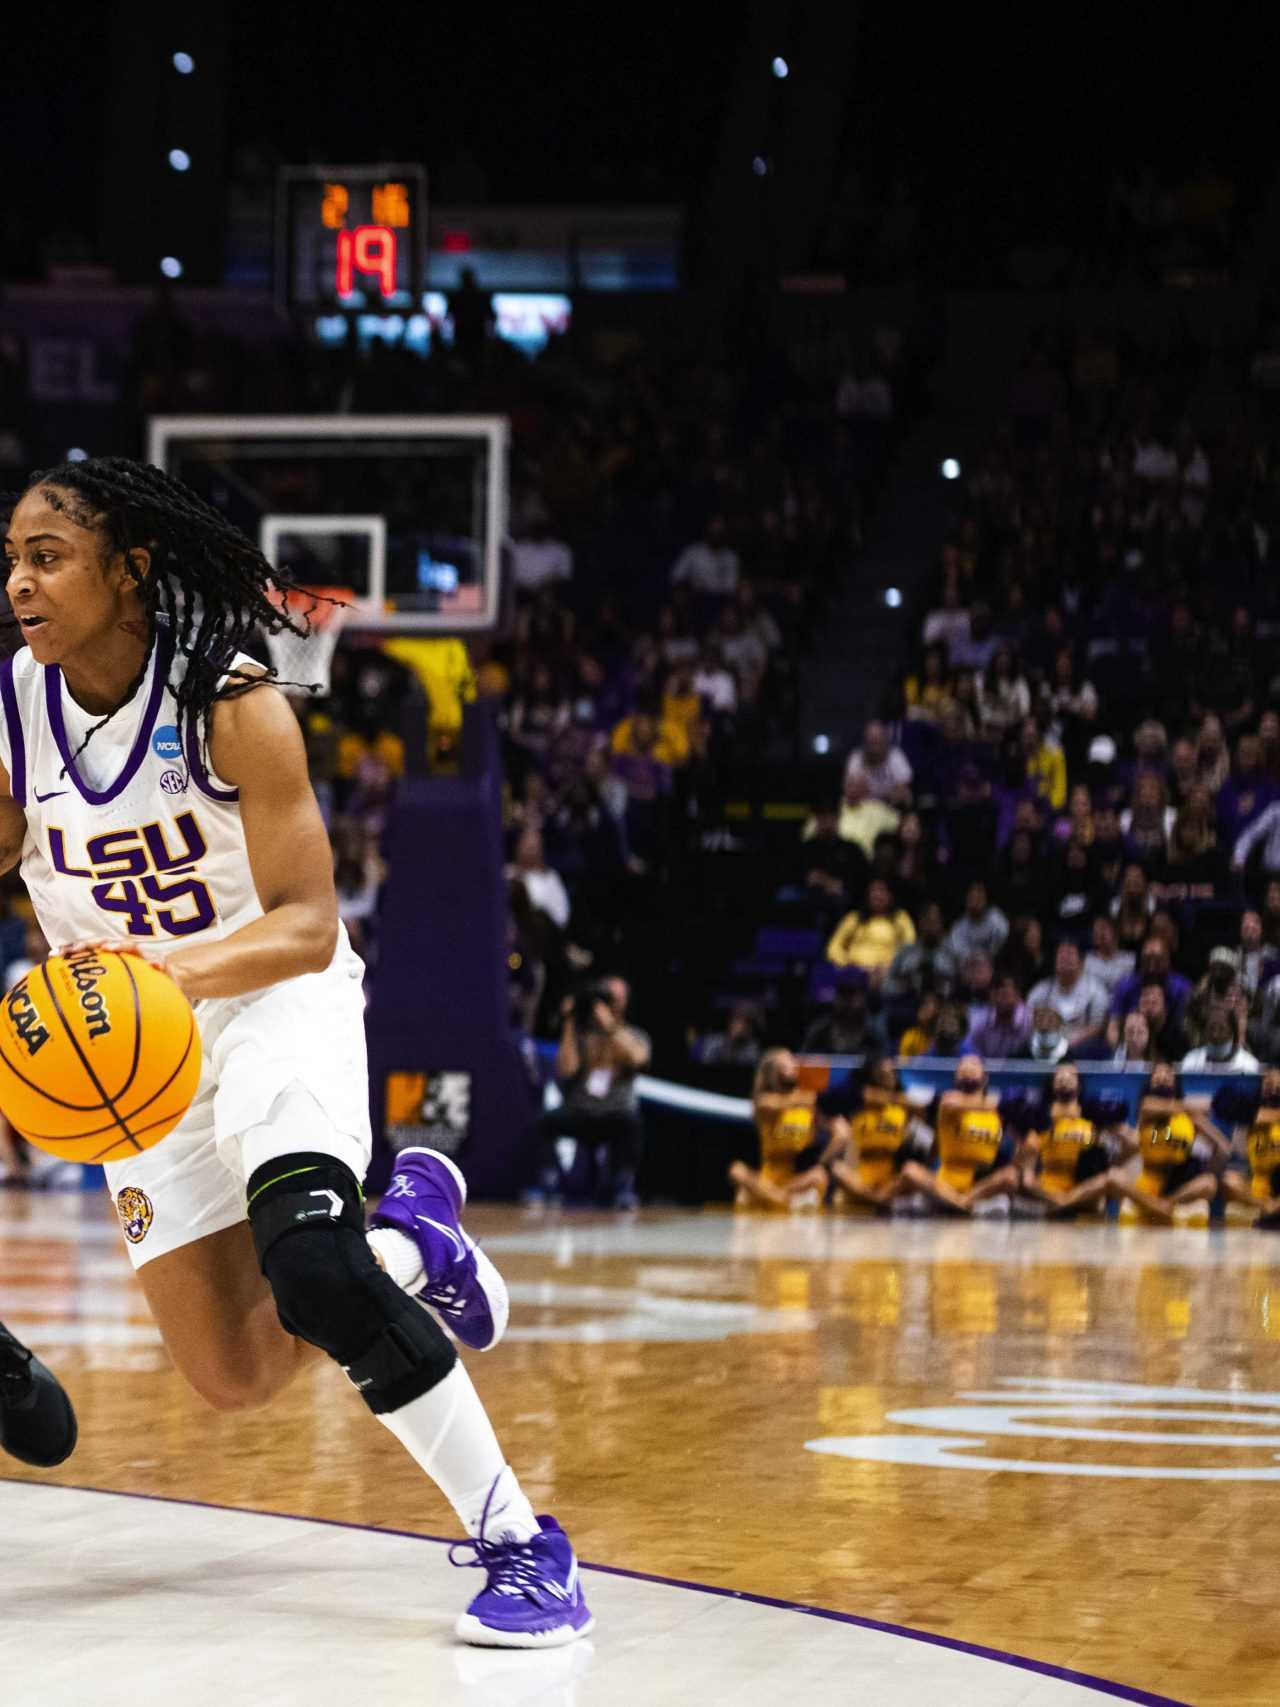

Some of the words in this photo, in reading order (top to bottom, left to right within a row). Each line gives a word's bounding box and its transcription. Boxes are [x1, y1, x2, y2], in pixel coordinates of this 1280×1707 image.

[336, 225, 398, 299] 19
[161, 771, 183, 794] SEC
[47, 809, 207, 879] LSU
[91, 866, 217, 937] 45
